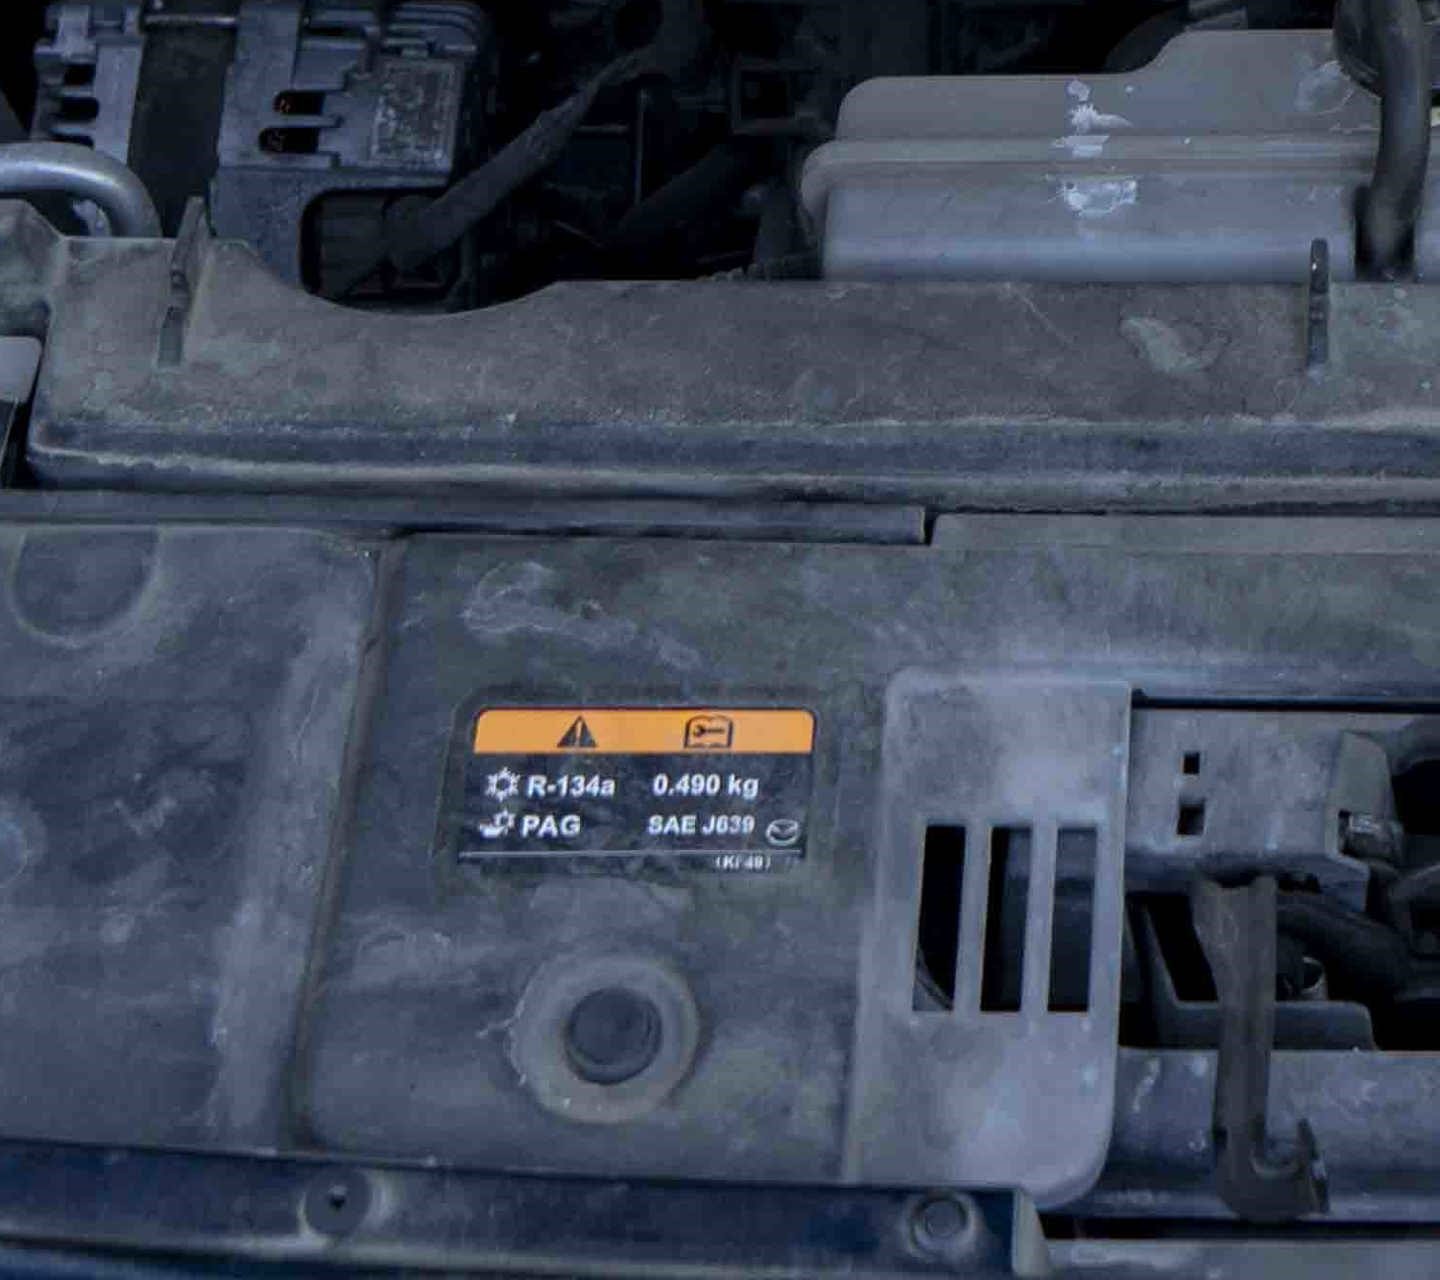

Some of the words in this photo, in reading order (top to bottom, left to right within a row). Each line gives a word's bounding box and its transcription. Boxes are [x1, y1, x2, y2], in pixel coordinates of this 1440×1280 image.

[526, 773, 616, 799] R-134a
[652, 772, 722, 797] 0.490
[726, 772, 760, 802] kg
[521, 813, 582, 838] PAG
[646, 813, 698, 836] SAE
[701, 813, 757, 836] J639
